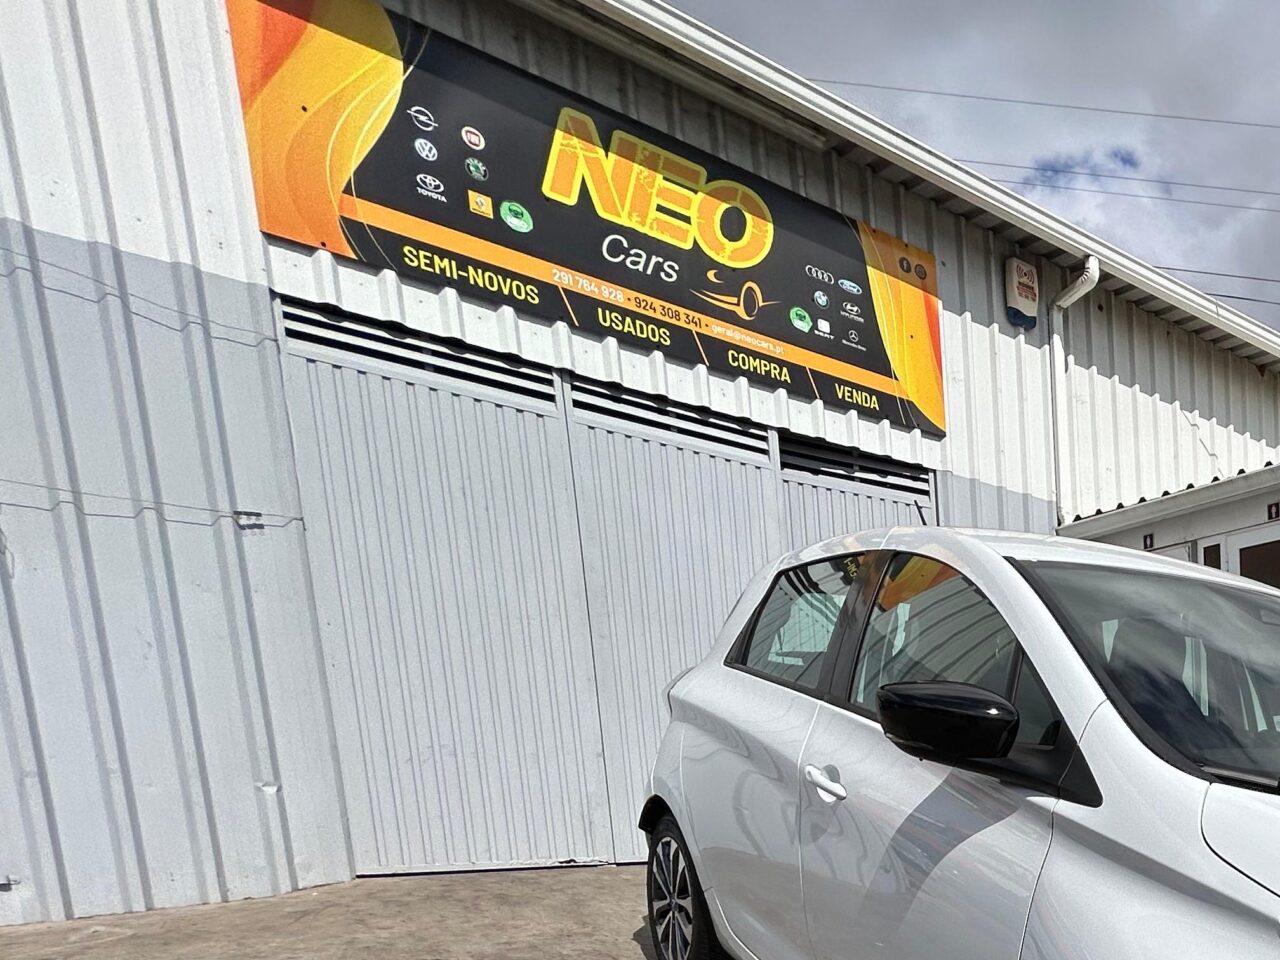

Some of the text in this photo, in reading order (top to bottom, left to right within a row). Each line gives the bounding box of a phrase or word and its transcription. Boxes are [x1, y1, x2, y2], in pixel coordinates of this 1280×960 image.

[416, 187, 448, 203] TOYOTA
[541, 106, 775, 269] NEO
[402, 245, 540, 305] SEMI-NOVOS
[602, 235, 680, 282] Cars
[551, 269, 574, 286] 291
[601, 284, 625, 303] 928
[634, 296, 657, 314] 924
[659, 304, 681, 322] 308
[684, 312, 702, 329] 341
[597, 307, 671, 346] USADOS
[728, 350, 791, 384] COMPRA
[834, 383, 880, 411] VENDA
